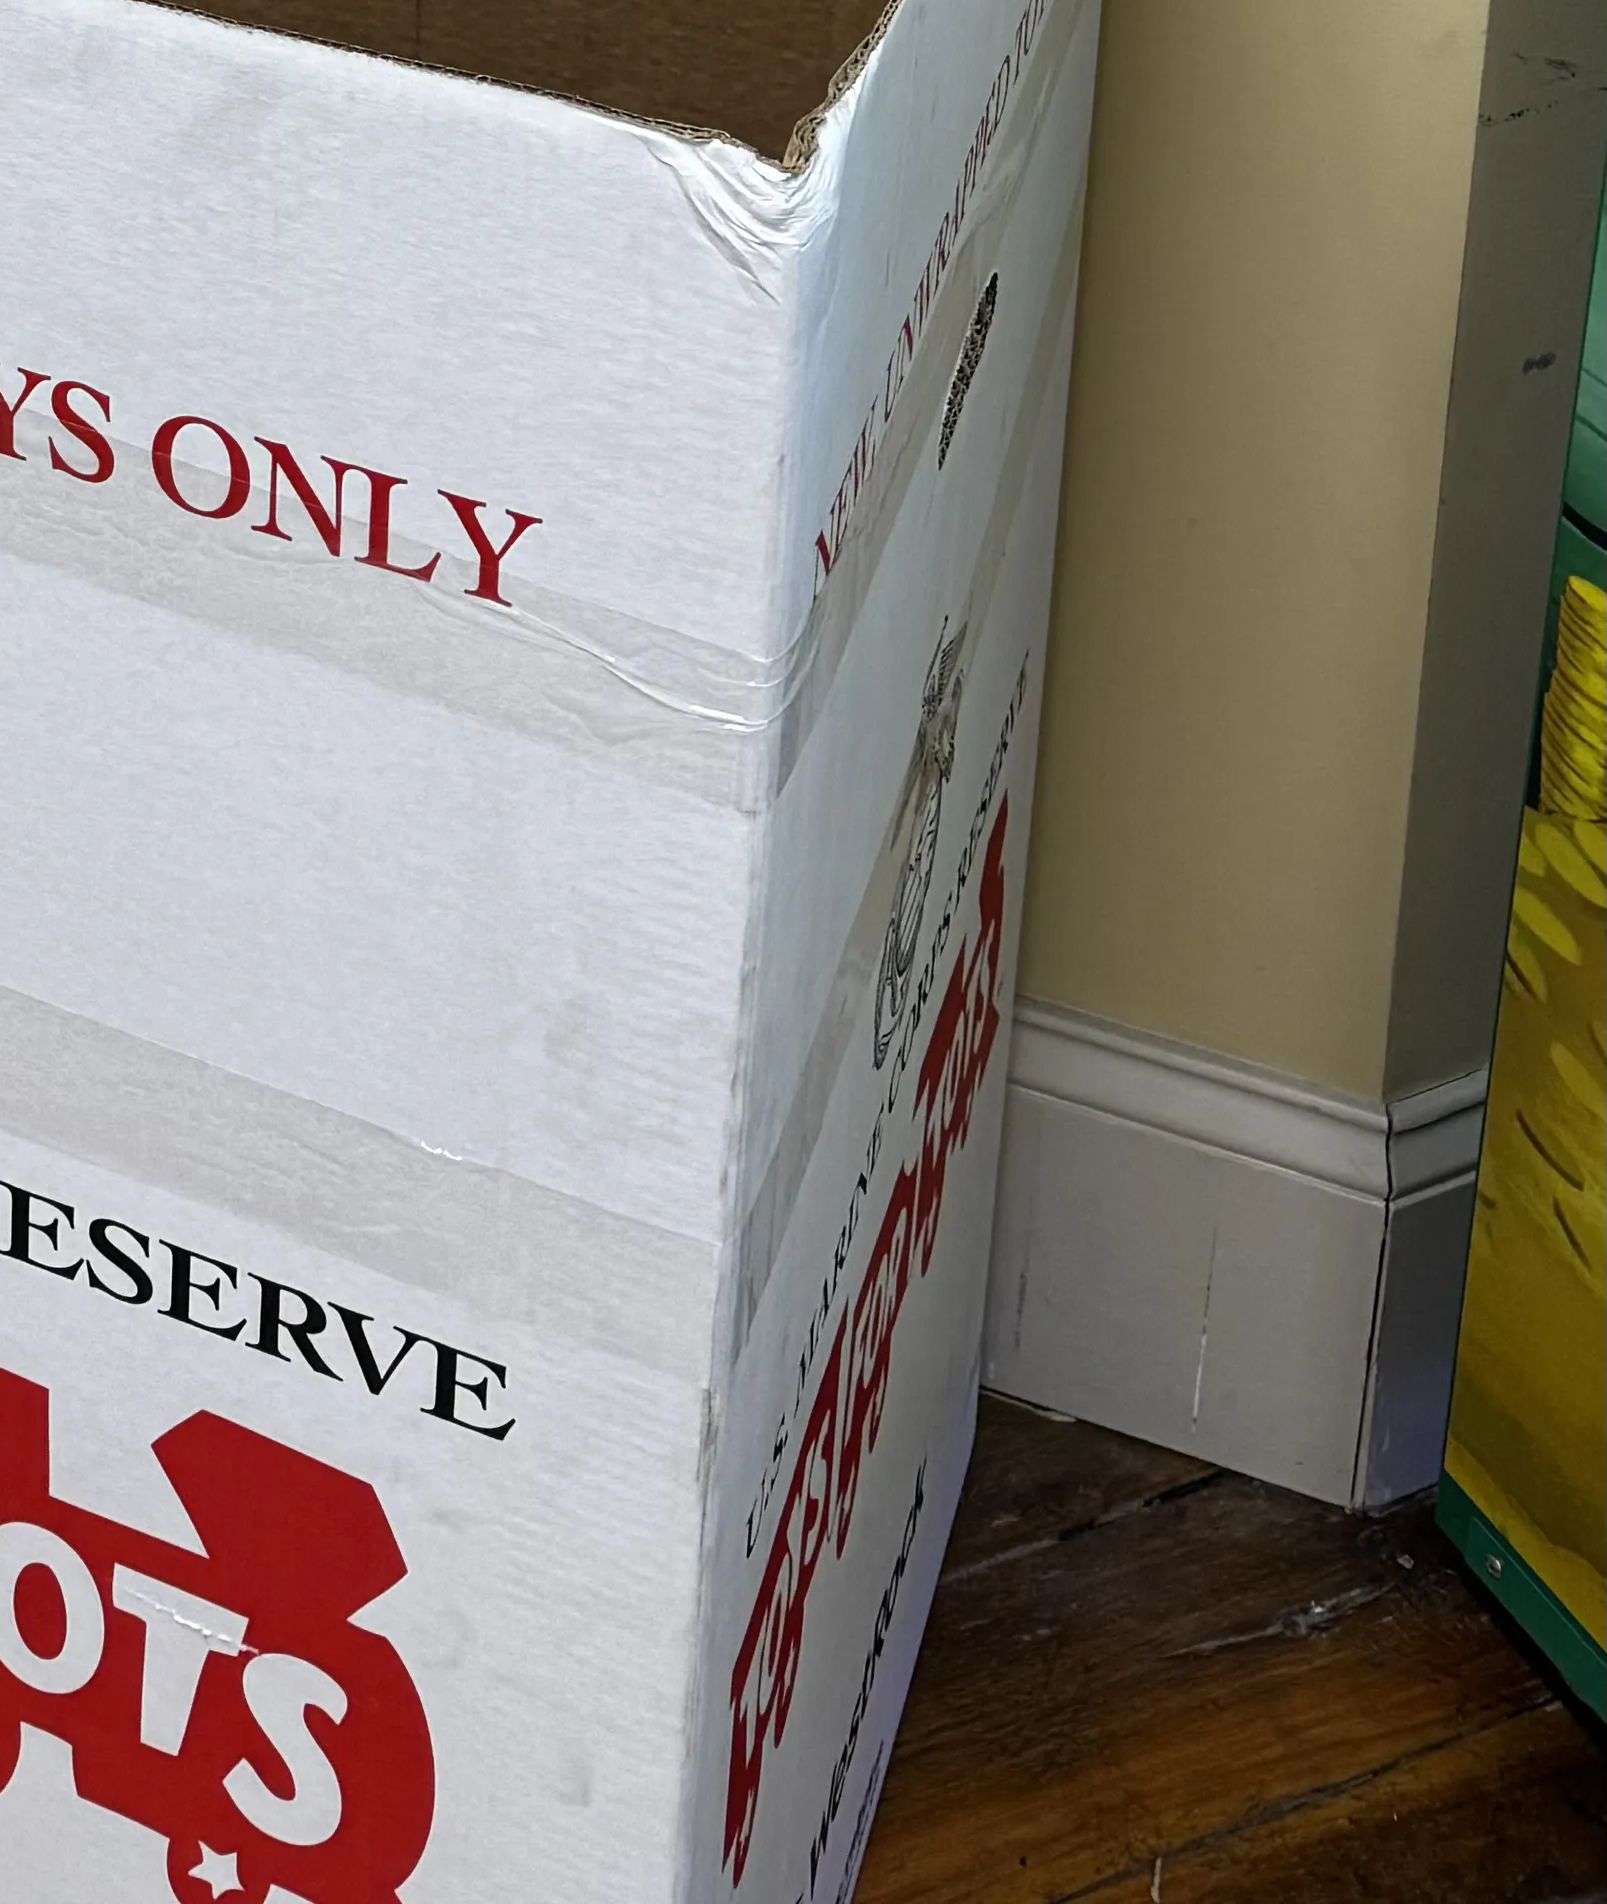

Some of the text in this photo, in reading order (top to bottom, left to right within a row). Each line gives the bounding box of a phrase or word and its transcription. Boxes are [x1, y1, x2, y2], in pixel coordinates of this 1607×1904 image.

[151, 416, 542, 605] ONLY
[884, 54, 1011, 424] UNWRAPPED
[793, 1101, 885, 1419] MARINE
[888, 890, 953, 1115] CORPS
[953, 647, 1030, 915] RESERVE
[739, 918, 995, 1770] TOYS FOR TOTS
